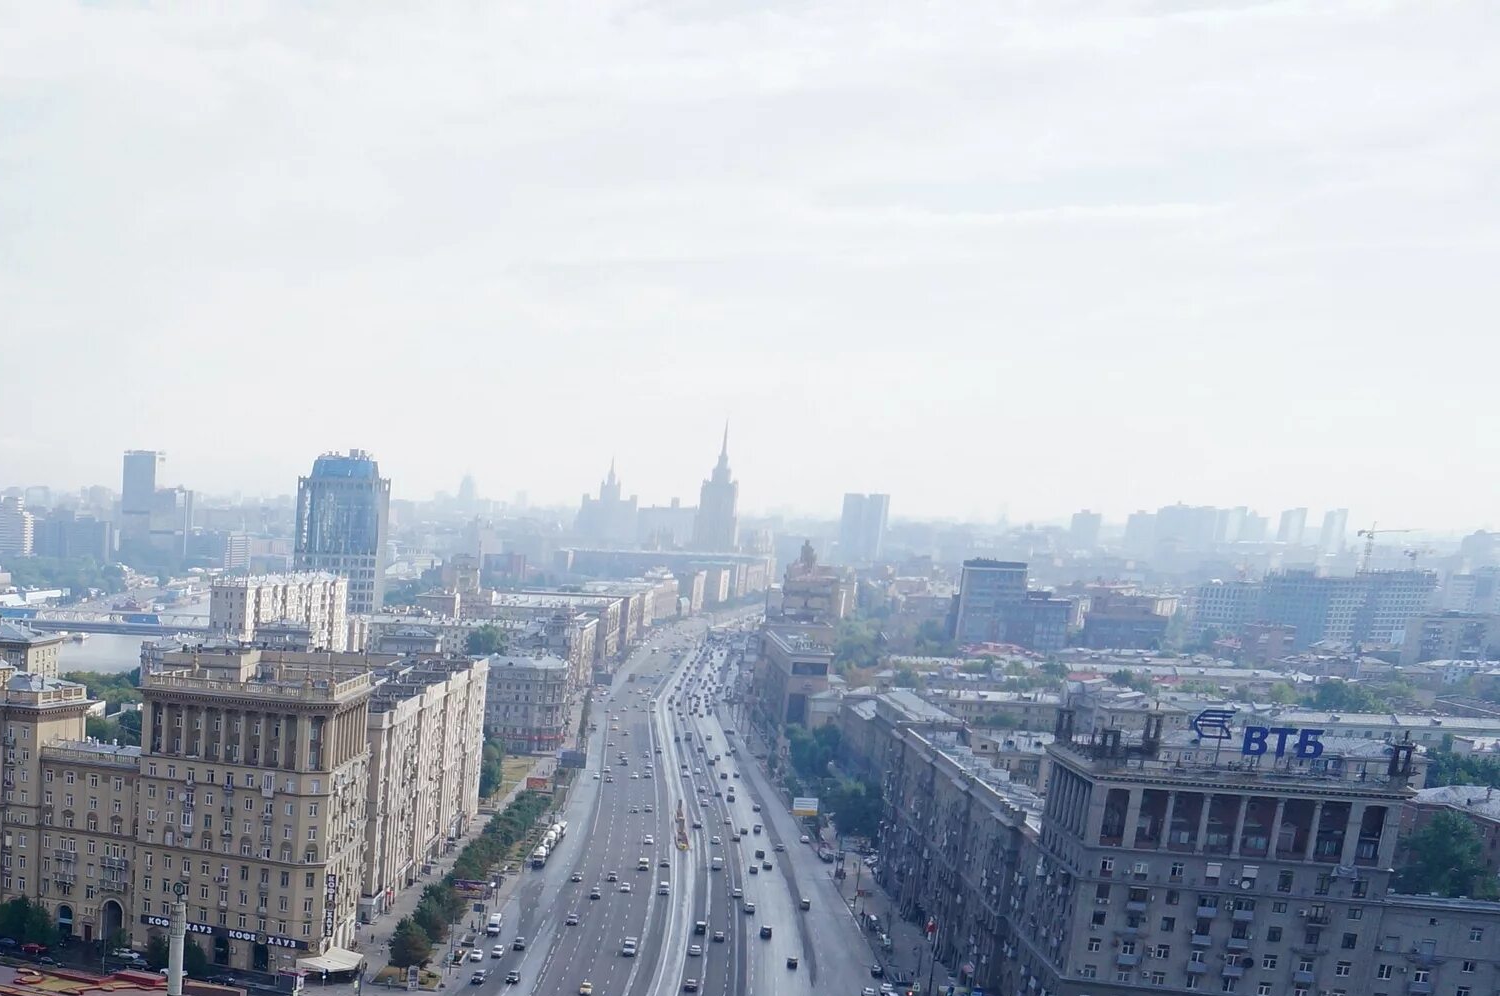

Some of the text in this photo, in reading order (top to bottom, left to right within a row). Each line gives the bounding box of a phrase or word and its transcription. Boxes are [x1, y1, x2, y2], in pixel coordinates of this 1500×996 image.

[1242, 725, 1325, 759] ВТБ
[148, 916, 212, 934] КОФ ХАУЗ
[229, 930, 296, 947] КОФЕ ХАУЗ
